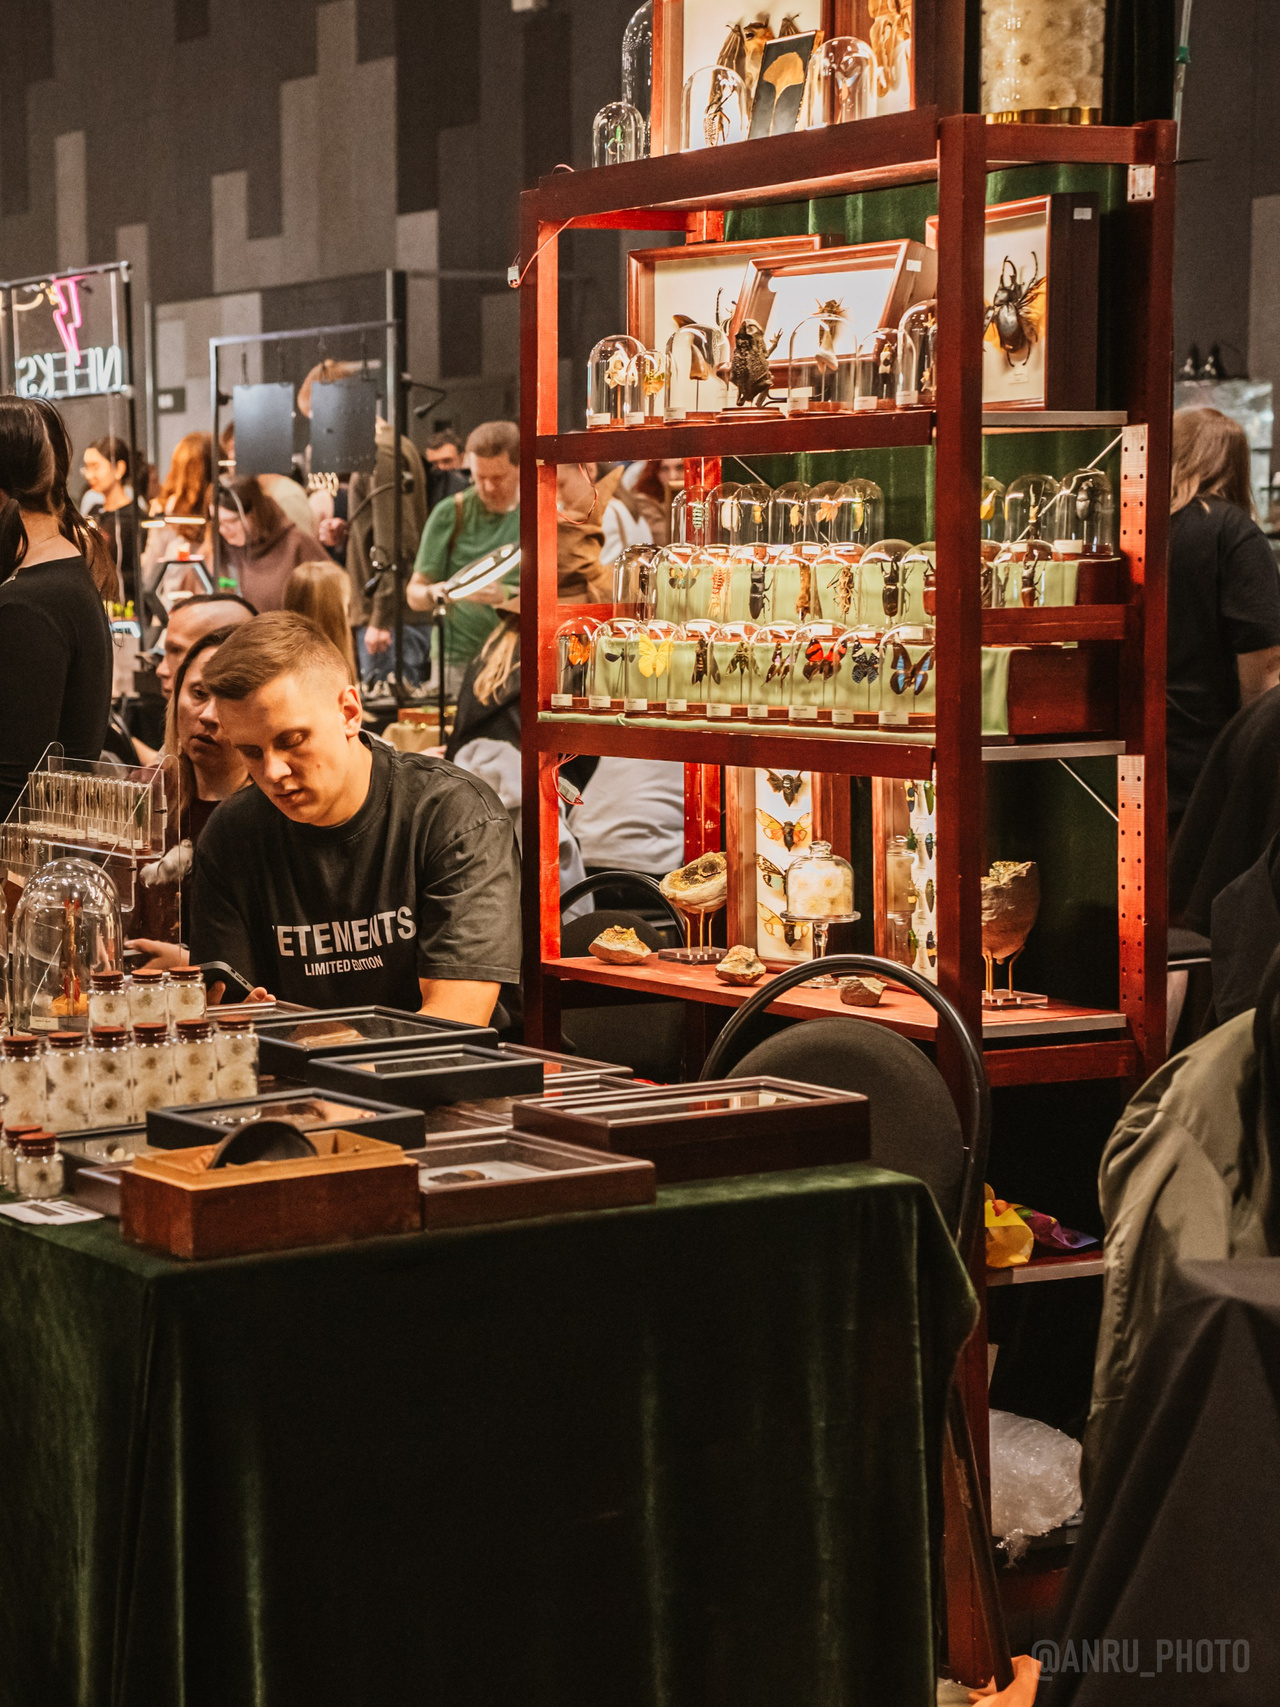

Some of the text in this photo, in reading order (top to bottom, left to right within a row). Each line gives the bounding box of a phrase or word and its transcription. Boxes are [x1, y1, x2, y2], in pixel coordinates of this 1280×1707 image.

[272, 906, 417, 956] ETEMENTS
[304, 955, 384, 976] LIMITED EDITION
